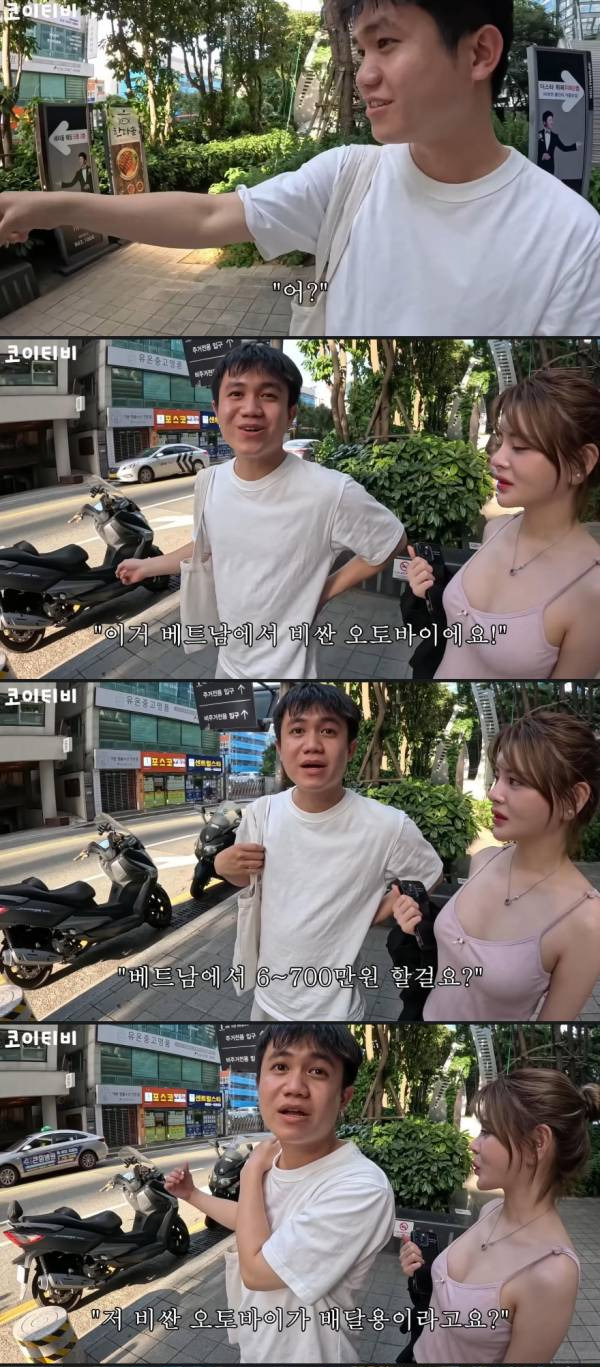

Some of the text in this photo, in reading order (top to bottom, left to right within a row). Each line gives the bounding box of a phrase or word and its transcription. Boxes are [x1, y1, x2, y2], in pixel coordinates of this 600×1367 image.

[165, 416, 186, 424] 포스코
[152, 758, 172, 766] 포스코
[152, 1092, 174, 1102] 포스코
